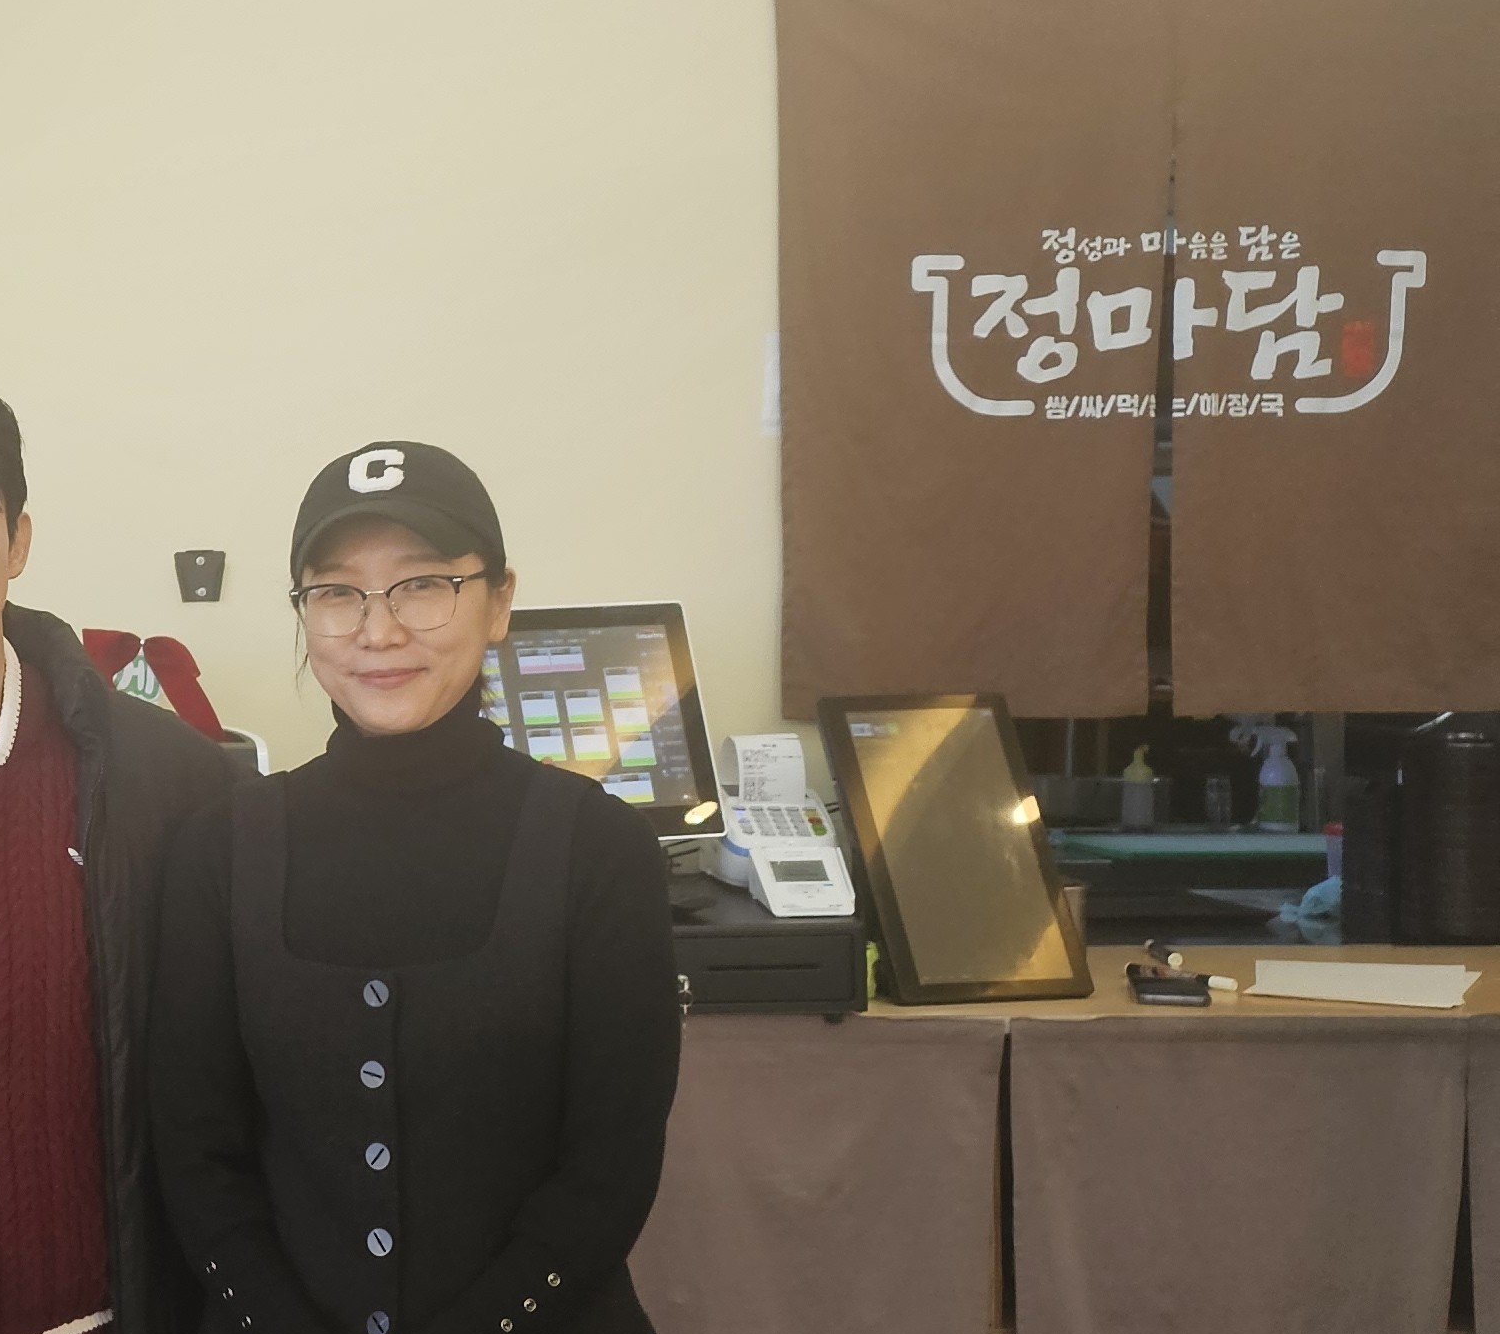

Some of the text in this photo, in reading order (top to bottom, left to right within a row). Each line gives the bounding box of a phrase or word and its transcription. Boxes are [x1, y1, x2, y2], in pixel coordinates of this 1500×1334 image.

[1041, 223, 1301, 264] 정성과 마음을 담은
[971, 266, 1344, 384] 정마담
[348, 448, 405, 494] C
